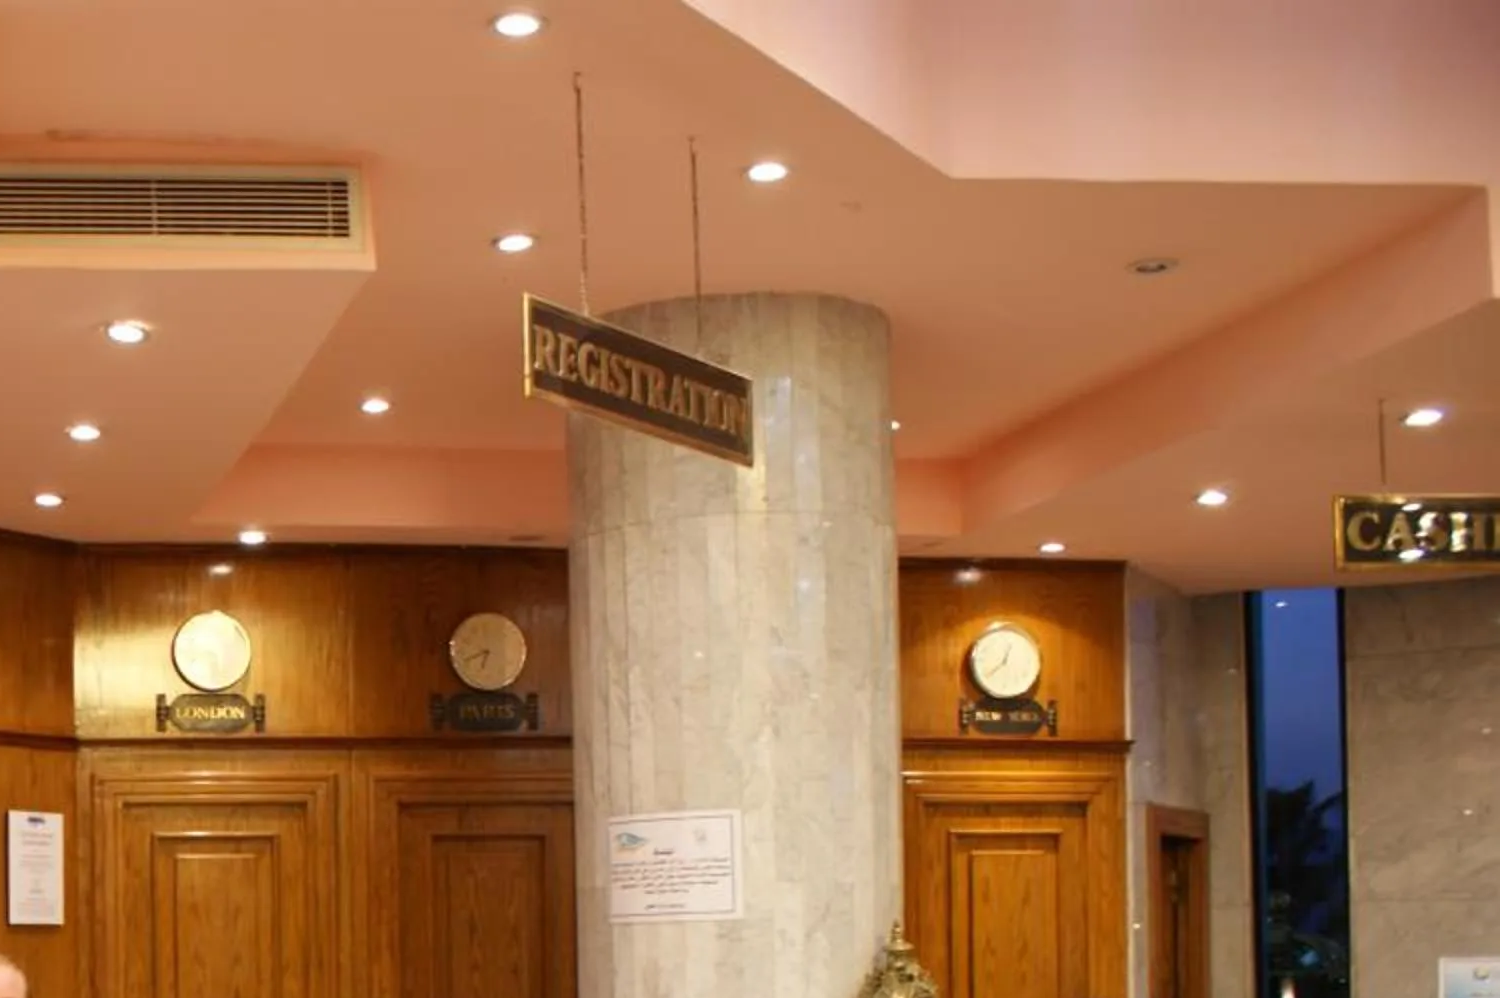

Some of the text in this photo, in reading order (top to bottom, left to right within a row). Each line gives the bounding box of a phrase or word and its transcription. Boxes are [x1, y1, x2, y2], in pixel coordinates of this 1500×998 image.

[532, 323, 748, 440] REGISTRATION
[175, 705, 245, 720] LONDON
[459, 704, 515, 721] PARIS
